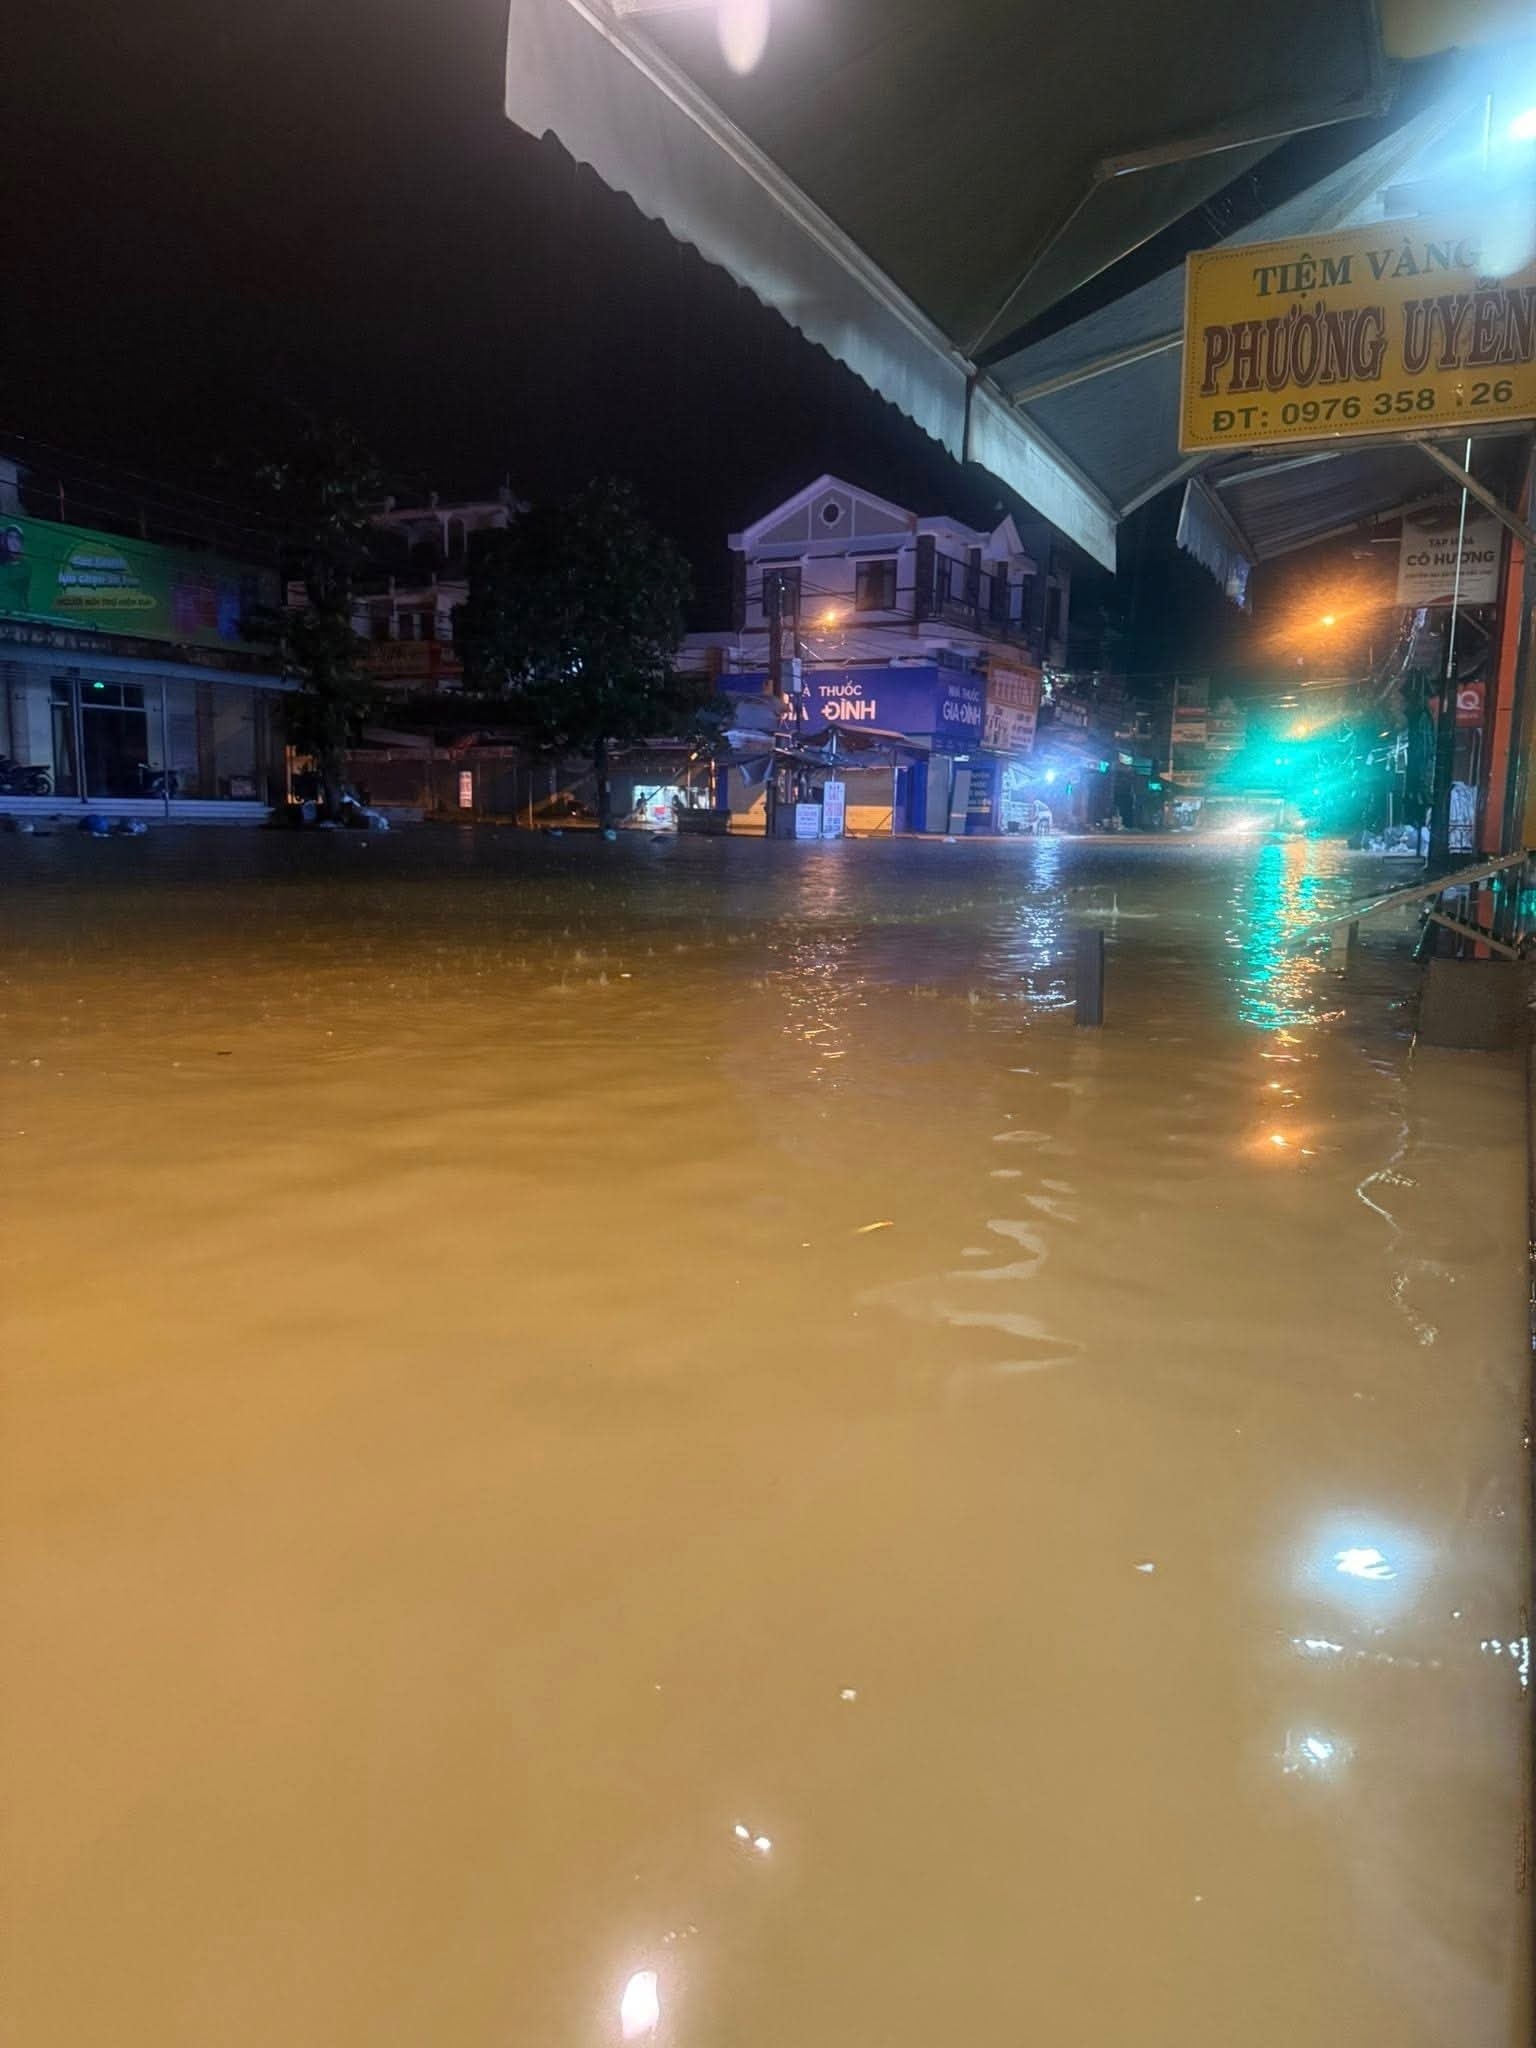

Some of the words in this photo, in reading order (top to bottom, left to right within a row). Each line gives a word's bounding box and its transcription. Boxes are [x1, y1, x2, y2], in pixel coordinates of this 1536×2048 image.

[1253, 253, 1353, 300] TIỆM
[1366, 237, 1480, 280] VÀNG
[1200, 300, 1386, 397] PHƯƠNG
[1212, 406, 1268, 432] ĐT:
[1281, 396, 1361, 425] 0976
[1373, 388, 1435, 415] 358
[818, 679, 863, 697] THUỐC
[821, 698, 877, 721] ĐÌNH
